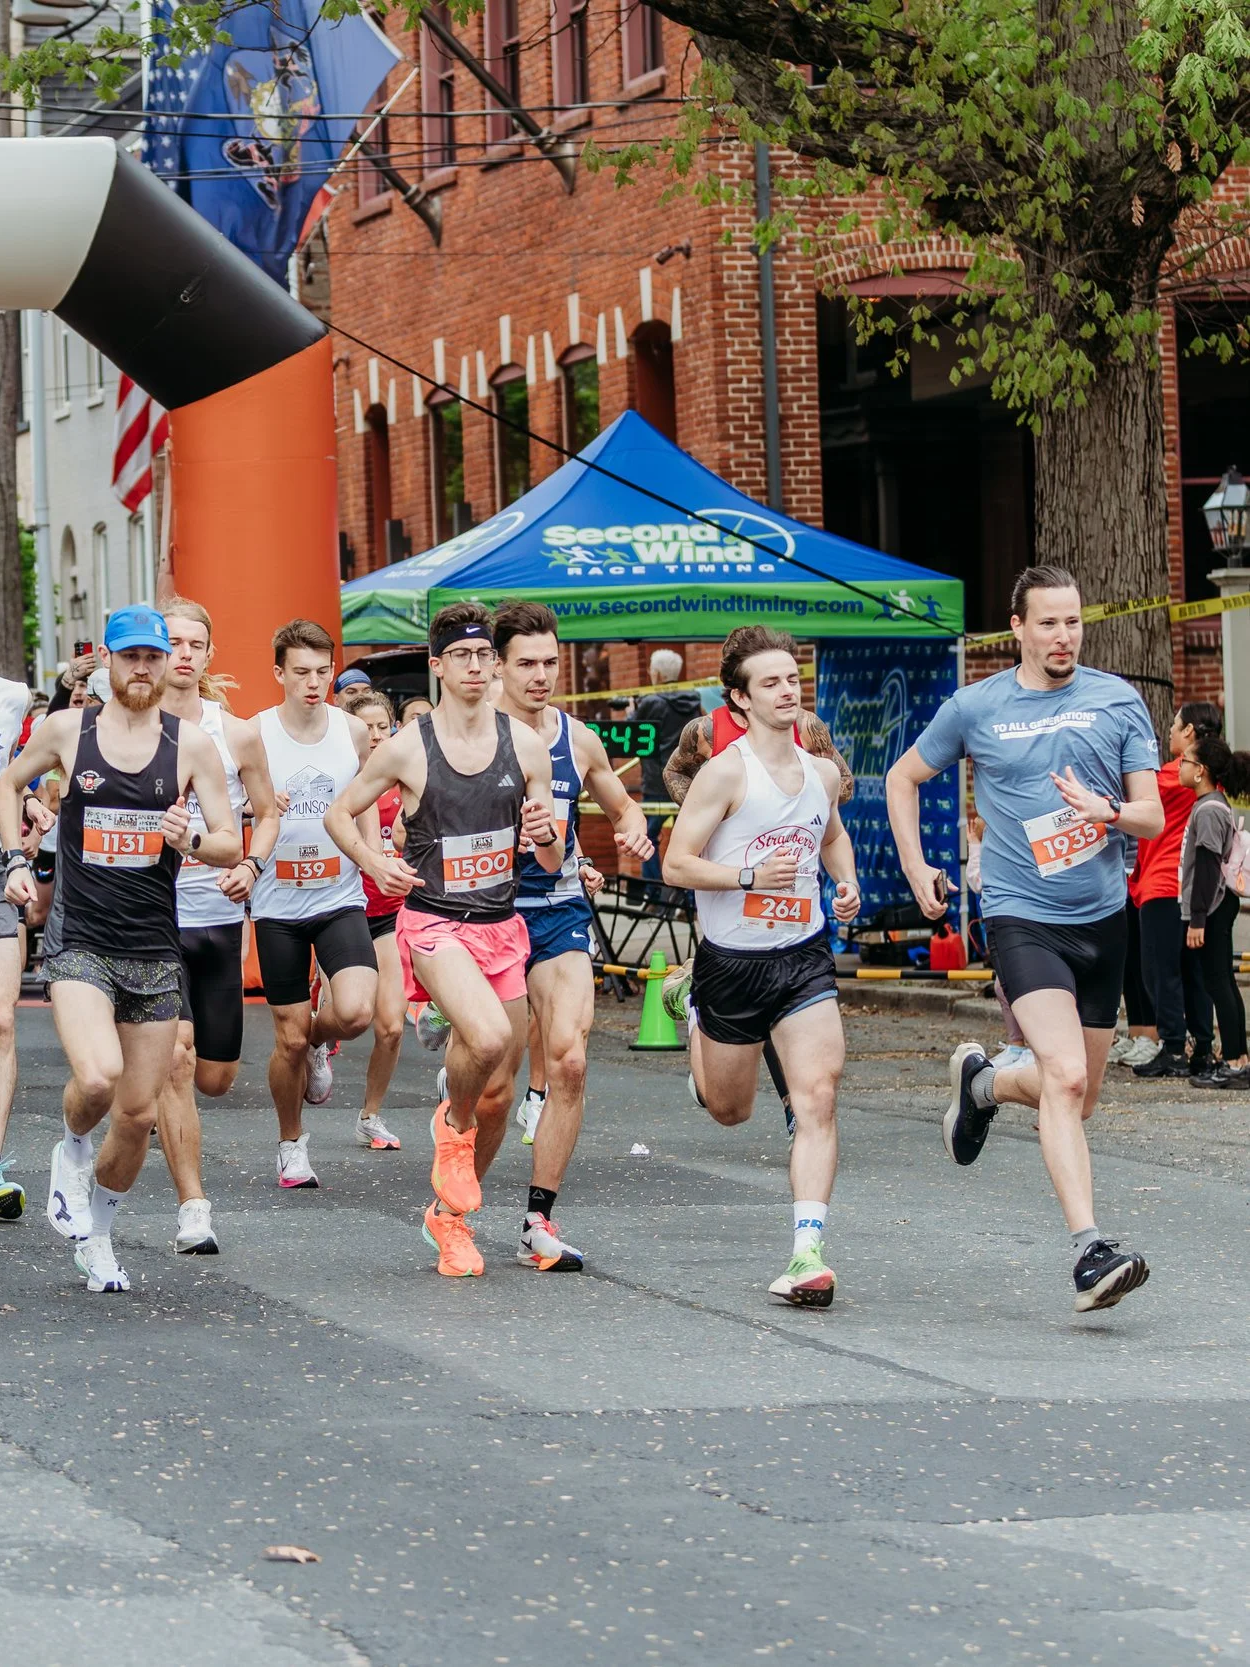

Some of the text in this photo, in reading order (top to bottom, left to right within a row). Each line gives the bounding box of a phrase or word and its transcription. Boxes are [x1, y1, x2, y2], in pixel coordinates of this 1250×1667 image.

[542, 520, 720, 546] Second
[631, 541, 755, 564] Wind
[567, 563, 775, 575] RACE TIMING
[547, 594, 864, 617] ww.secondwindtiming.com
[992, 711, 1097, 733] TO ALL GENERATIONS
[101, 833, 145, 853] 1131
[1042, 823, 1098, 859] 1935
[291, 861, 326, 878] 139
[451, 852, 509, 879] 1500
[760, 897, 802, 919] 264
